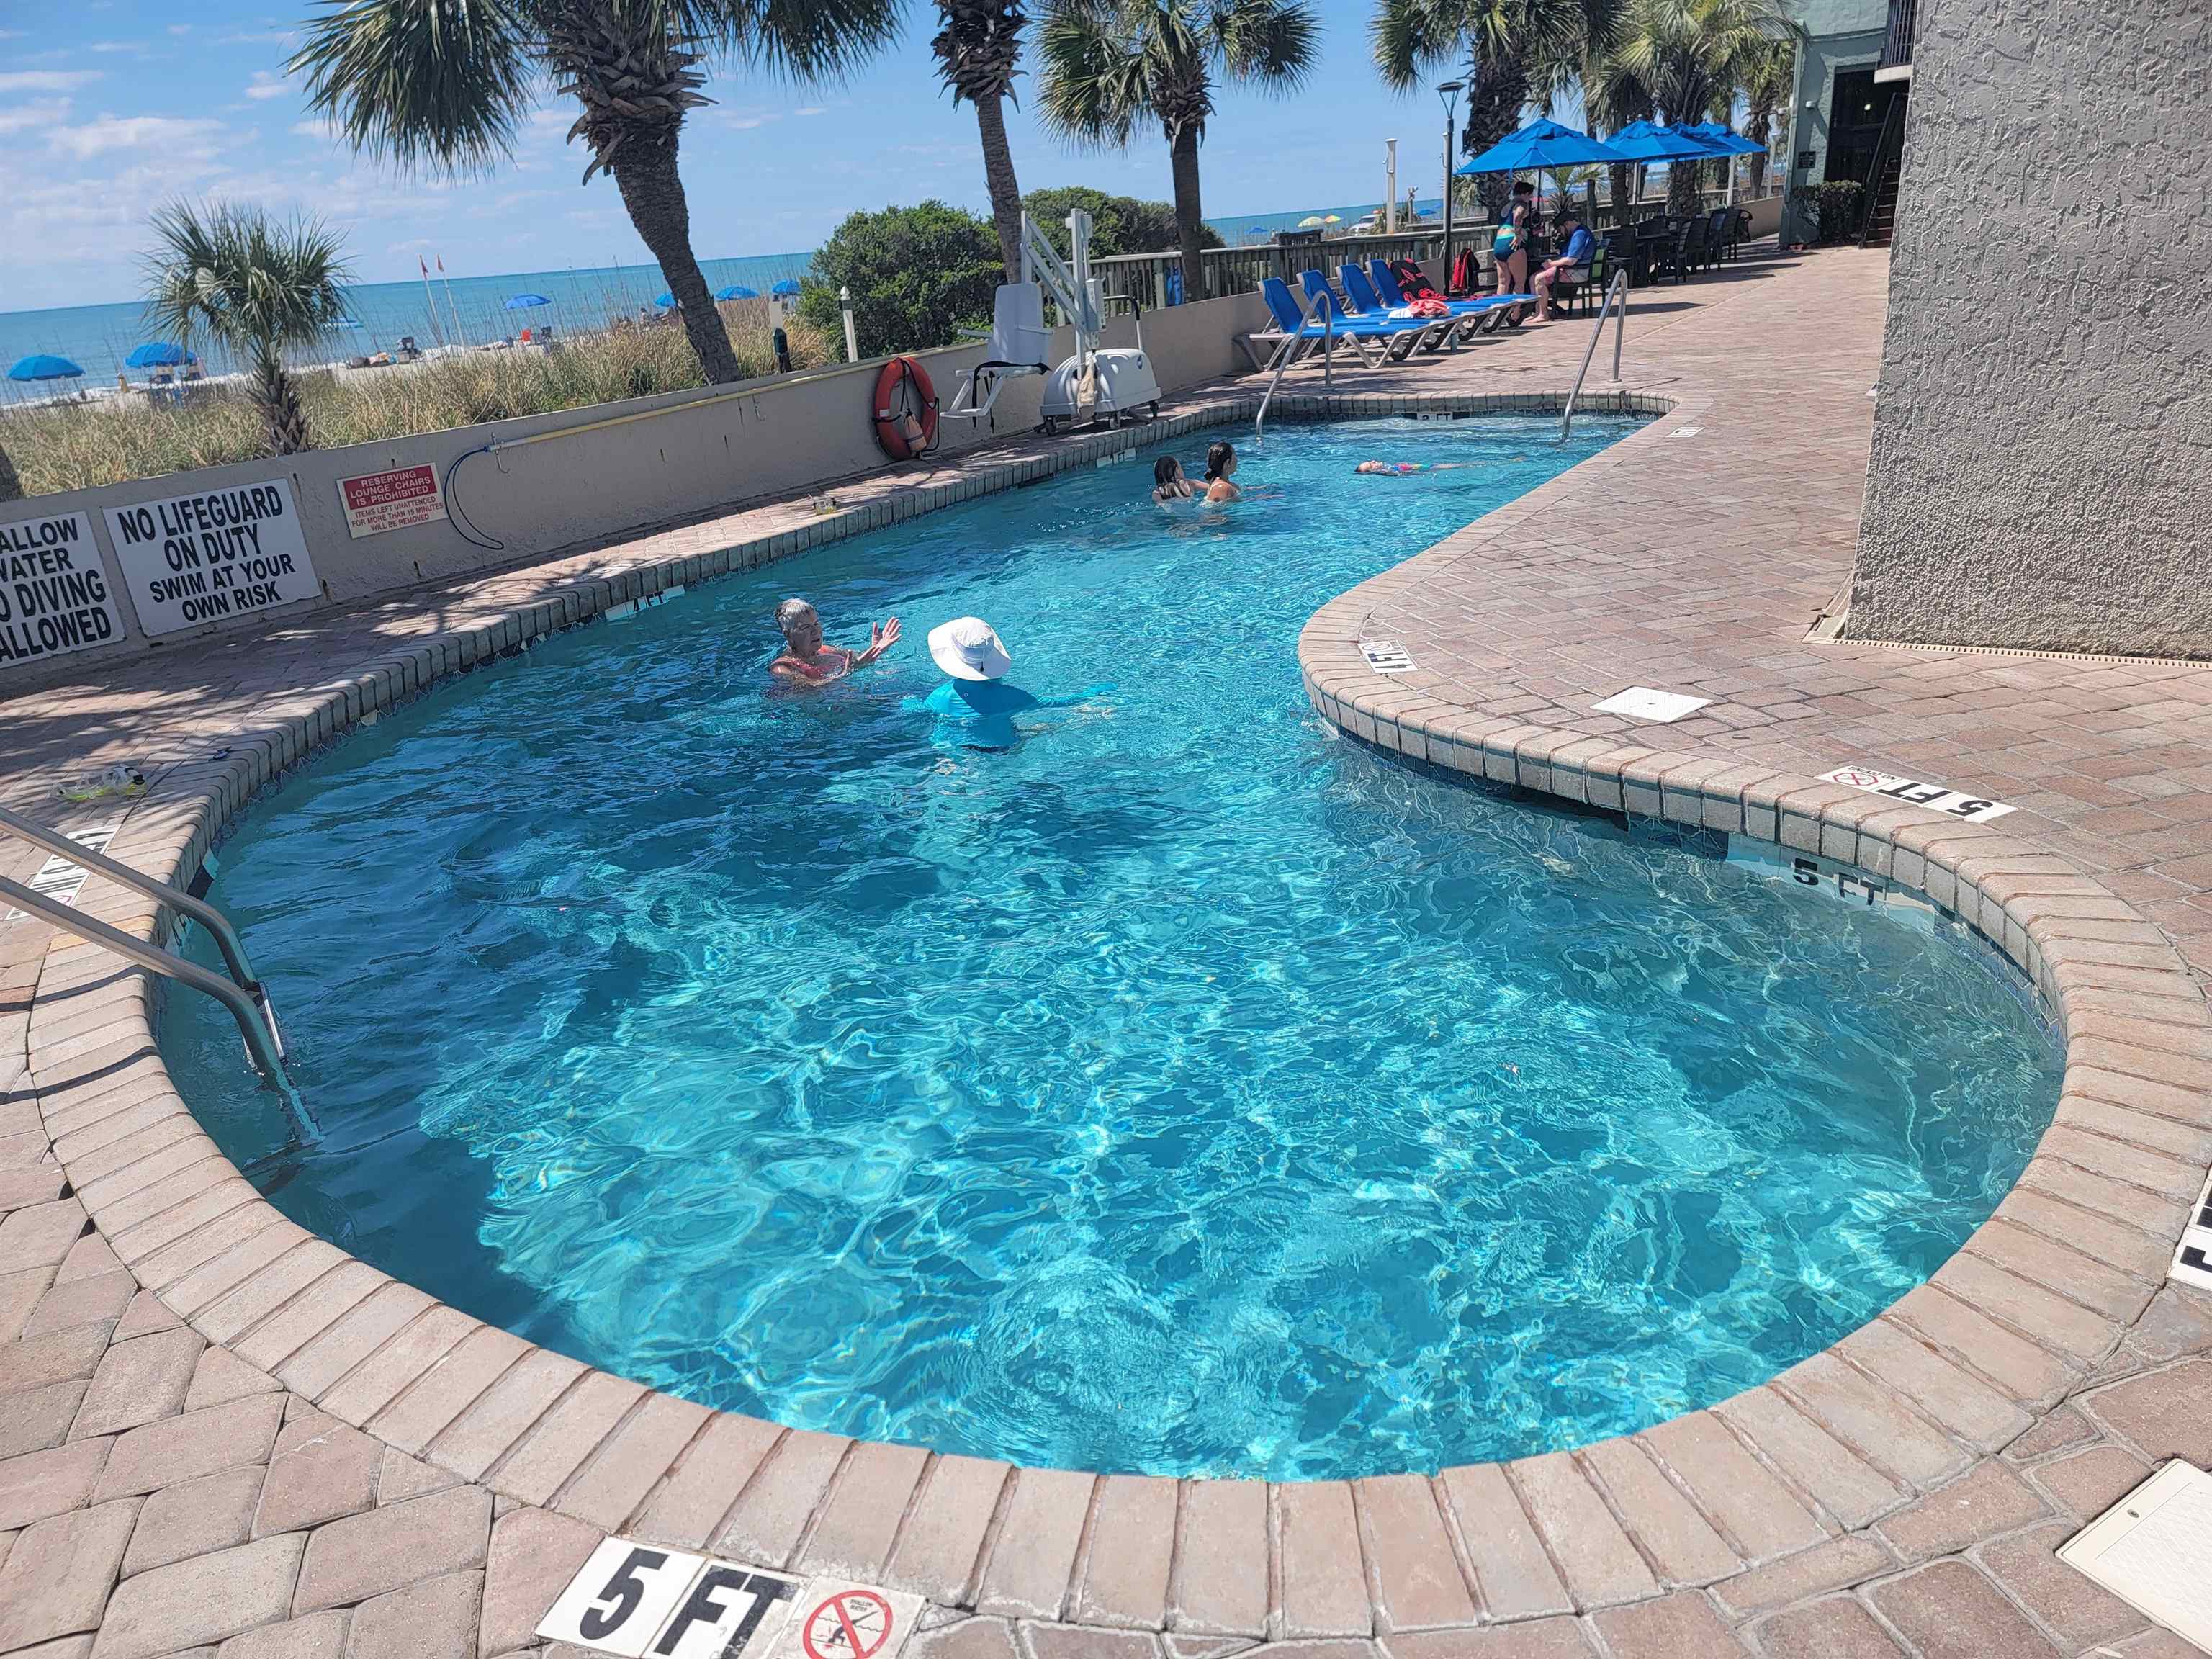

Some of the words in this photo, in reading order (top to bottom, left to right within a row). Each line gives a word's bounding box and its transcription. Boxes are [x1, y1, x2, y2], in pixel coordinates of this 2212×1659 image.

[350, 485, 391, 498] LOUNGE
[395, 477, 431, 490] CHAIRS
[361, 470, 416, 487] RESERVING
[372, 485, 429, 503] PROHIBITED
[117, 508, 156, 544] NO
[158, 485, 283, 536] LIFEGUARD
[351, 518, 367, 527] FOR
[367, 515, 387, 524] MORE
[389, 511, 405, 520] THAN
[416, 503, 444, 513] MINUTES
[355, 508, 375, 518] ITEMS
[377, 505, 392, 514] LEFT
[395, 496, 436, 510] UNATTENDED
[371, 523, 387, 531] WILL
[399, 513, 429, 526] REMOVED
[0, 518, 78, 554] ALLOW
[164, 537, 201, 572] ON
[201, 523, 261, 564] DUTY
[14, 570, 106, 618] DIVING
[150, 572, 207, 603] SWIM
[213, 565, 235, 590] AT
[240, 553, 295, 583] YOUR
[182, 593, 230, 621] OWN
[233, 581, 282, 610] RISK
[0, 607, 112, 662] ALLOWED
[1877, 782, 1952, 804] FT
[1945, 799, 1994, 818] 5
[1793, 857, 1819, 886] 5
[1838, 872, 1884, 906] FT
[580, 1547, 670, 1640] 5
[653, 1565, 800, 1659] FT
